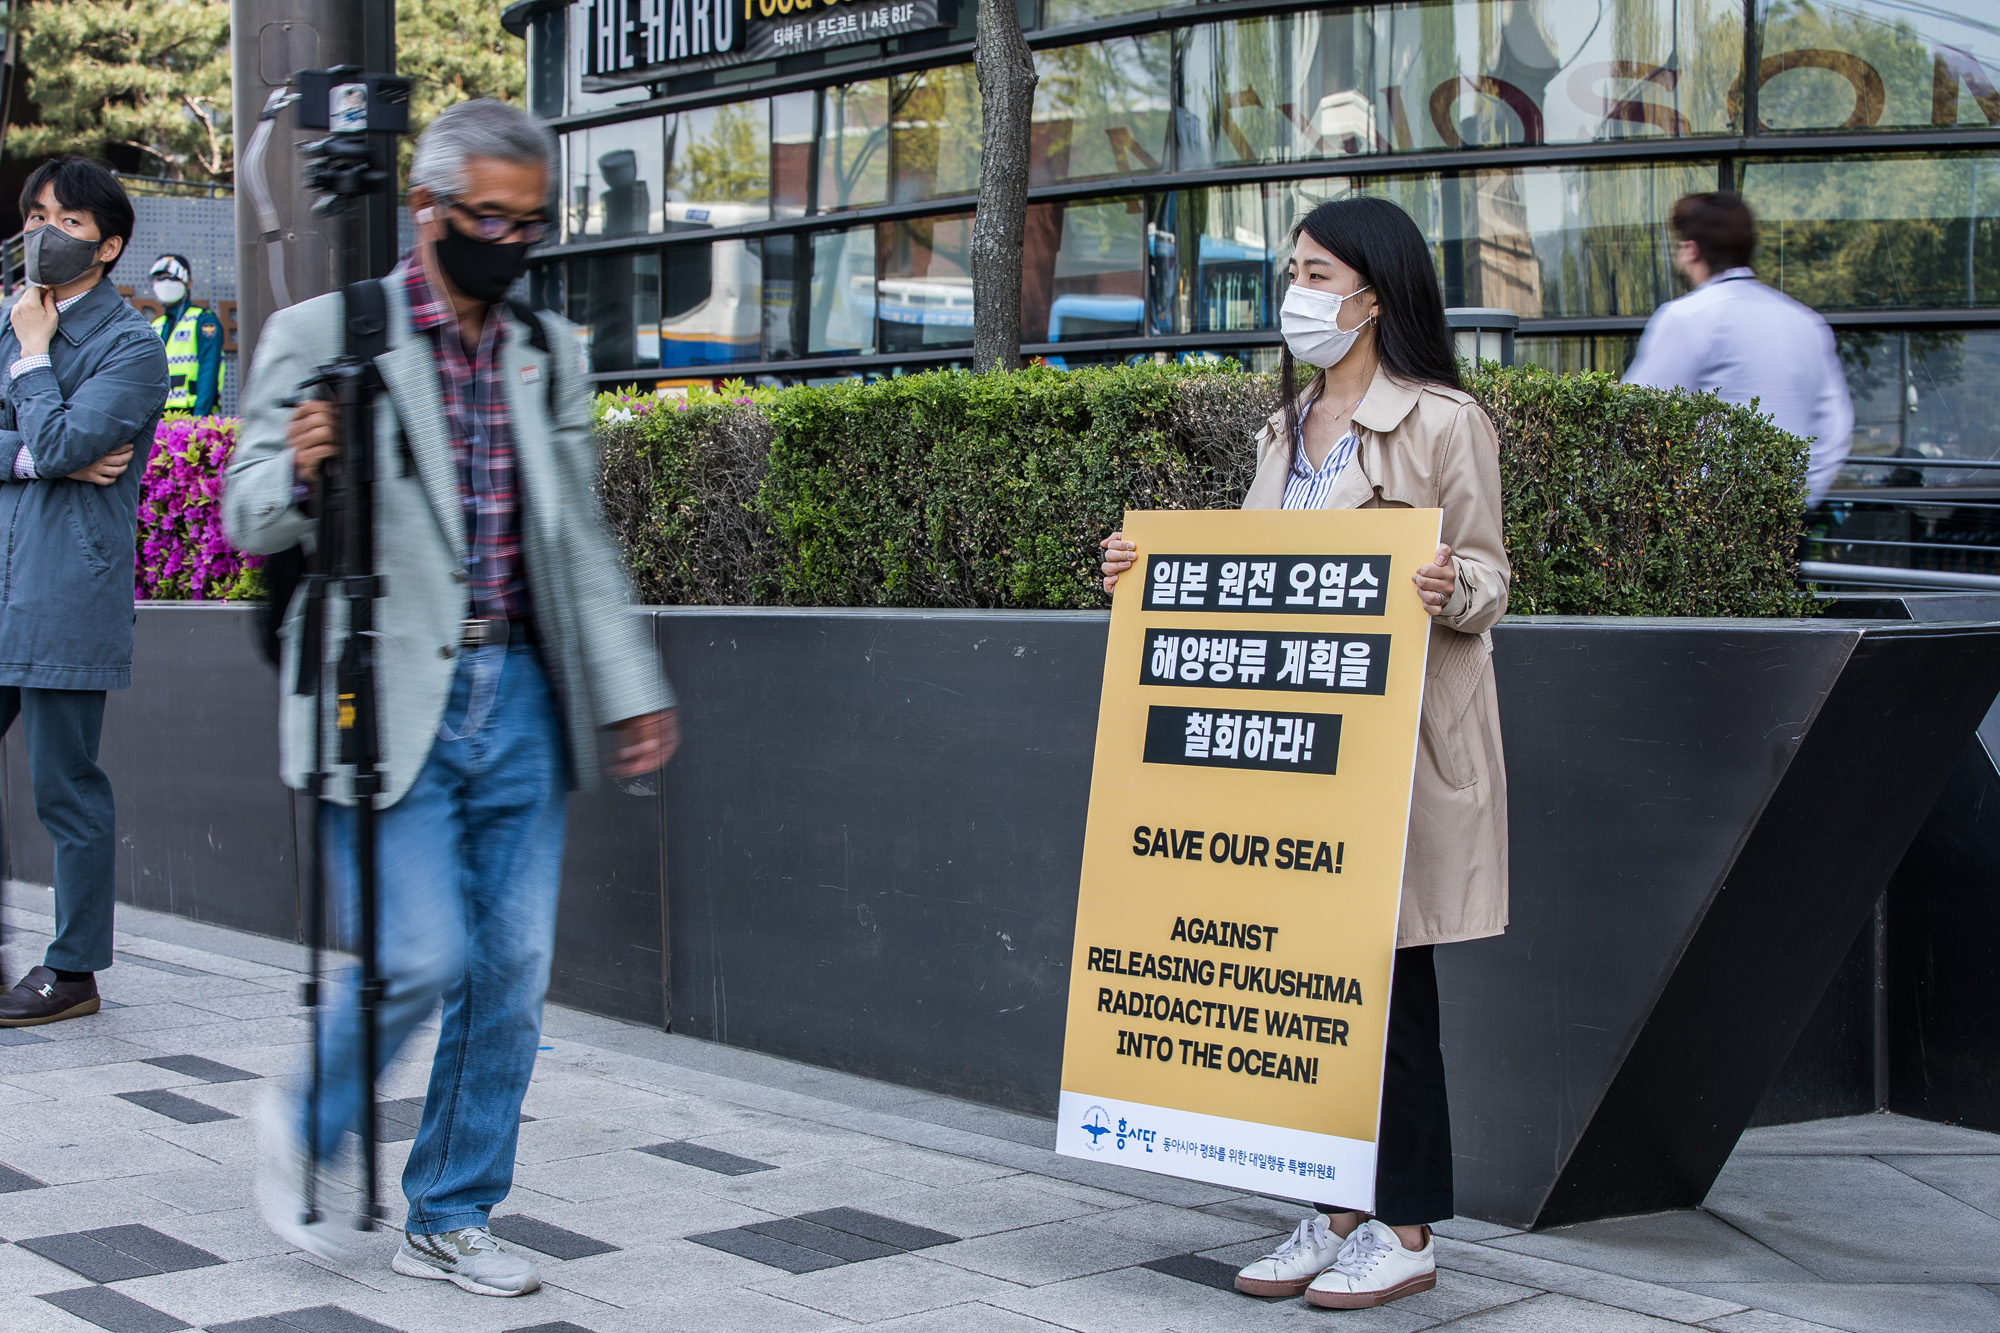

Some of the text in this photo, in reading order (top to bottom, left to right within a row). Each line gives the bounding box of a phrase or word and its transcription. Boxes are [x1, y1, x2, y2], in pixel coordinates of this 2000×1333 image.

[578, 0, 635, 75] THE
[773, 3, 914, 47] 더하루 푸드코트 A동 B1F
[1152, 562, 1378, 608] 일본 원전 오염수
[1152, 635, 1370, 687] 해양방류 계획을
[1184, 711, 1315, 764] 철회하라!
[1133, 826, 1344, 873] SAVE OUR SEA!
[1171, 917, 1278, 951] AGAINST
[1088, 947, 1363, 1005] RELEASING FUKUSHIMA
[1097, 988, 1349, 1046] RADIOACTIVE WATER
[1117, 1030, 1318, 1084] INTO THE OCEAN!
[1116, 1118, 1156, 1153] 흥사단
[1163, 1137, 1198, 1156] 동아시아
[1200, 1143, 1226, 1162] 평화를
[1228, 1148, 1247, 1166] 위한
[1249, 1152, 1285, 1173] 대일행동
[1287, 1159, 1336, 1181] 특별위원회
